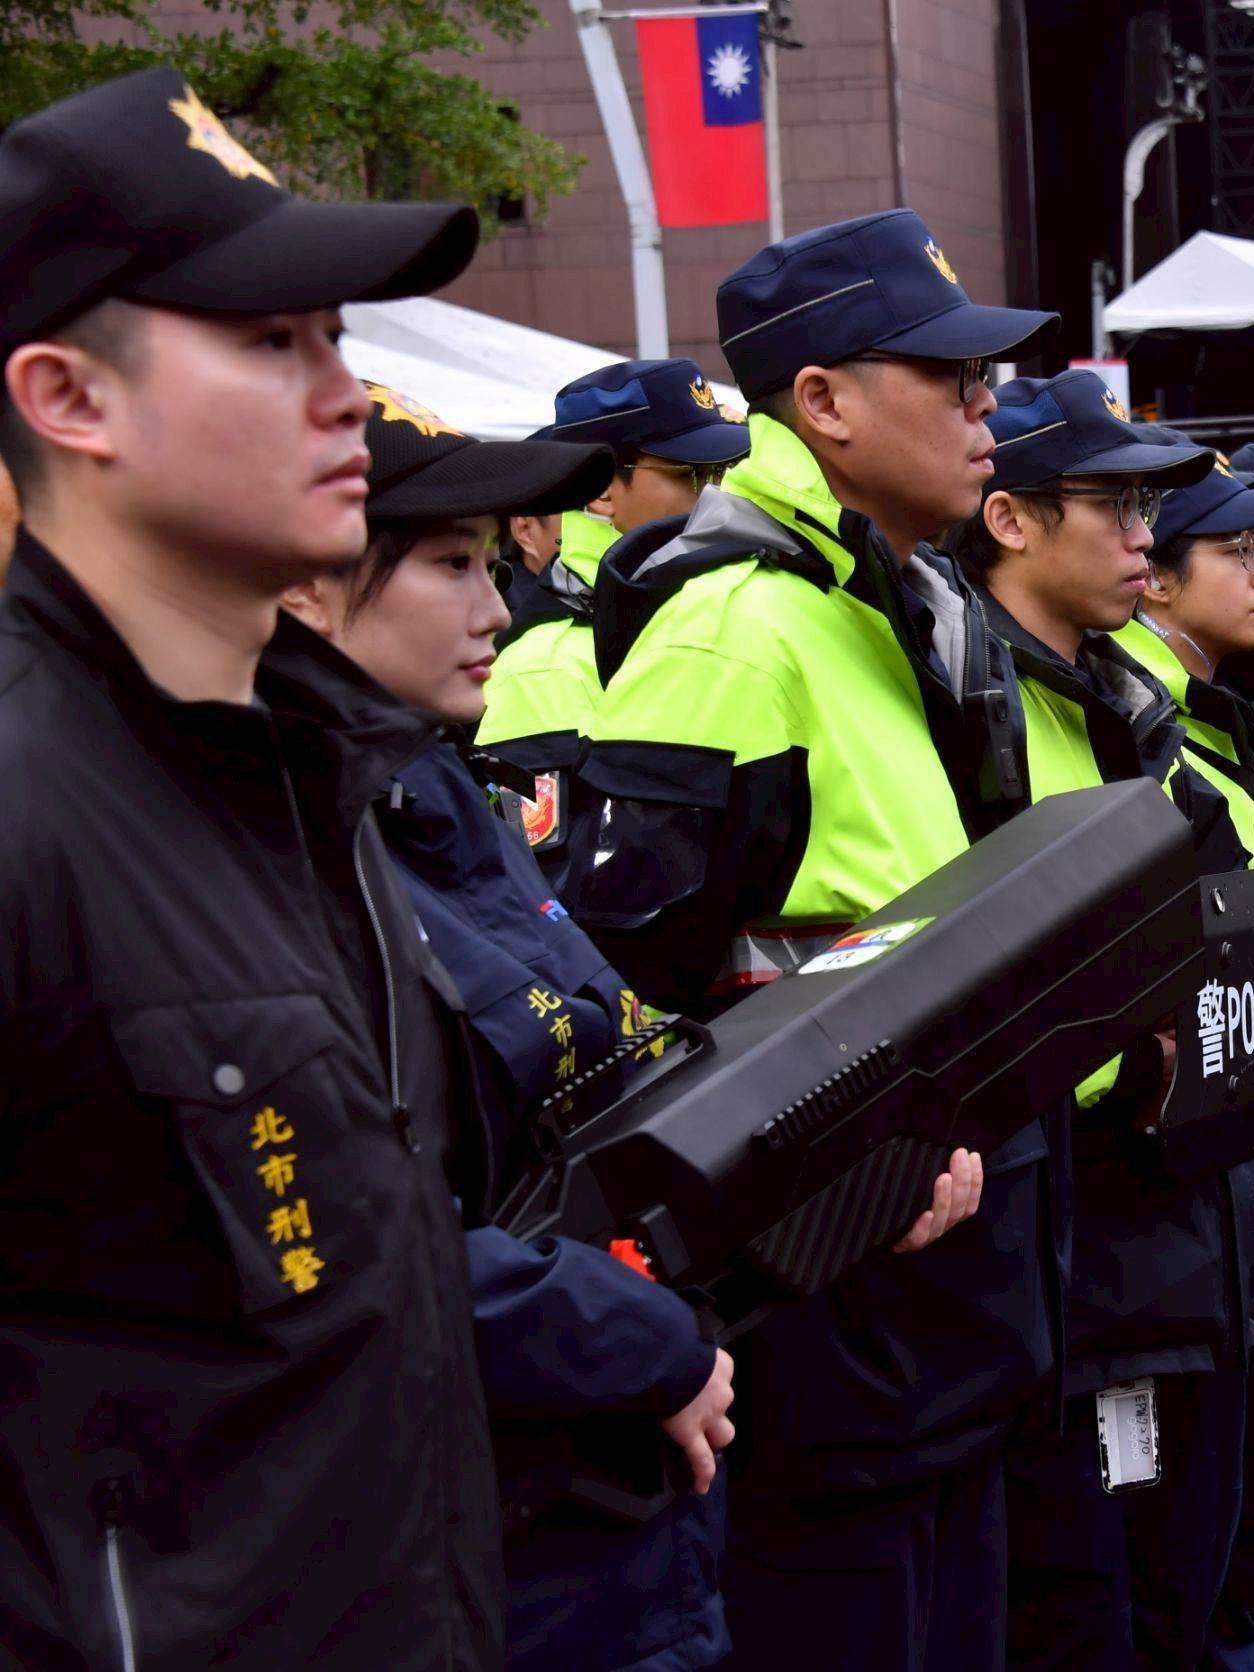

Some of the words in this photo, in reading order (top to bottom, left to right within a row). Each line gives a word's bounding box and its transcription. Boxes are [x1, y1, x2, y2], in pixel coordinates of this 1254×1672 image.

[527, 987, 577, 1113] 北市刑
[250, 1106, 325, 1294] 北市刑警
[1127, 1416, 1140, 1460] gogoro
